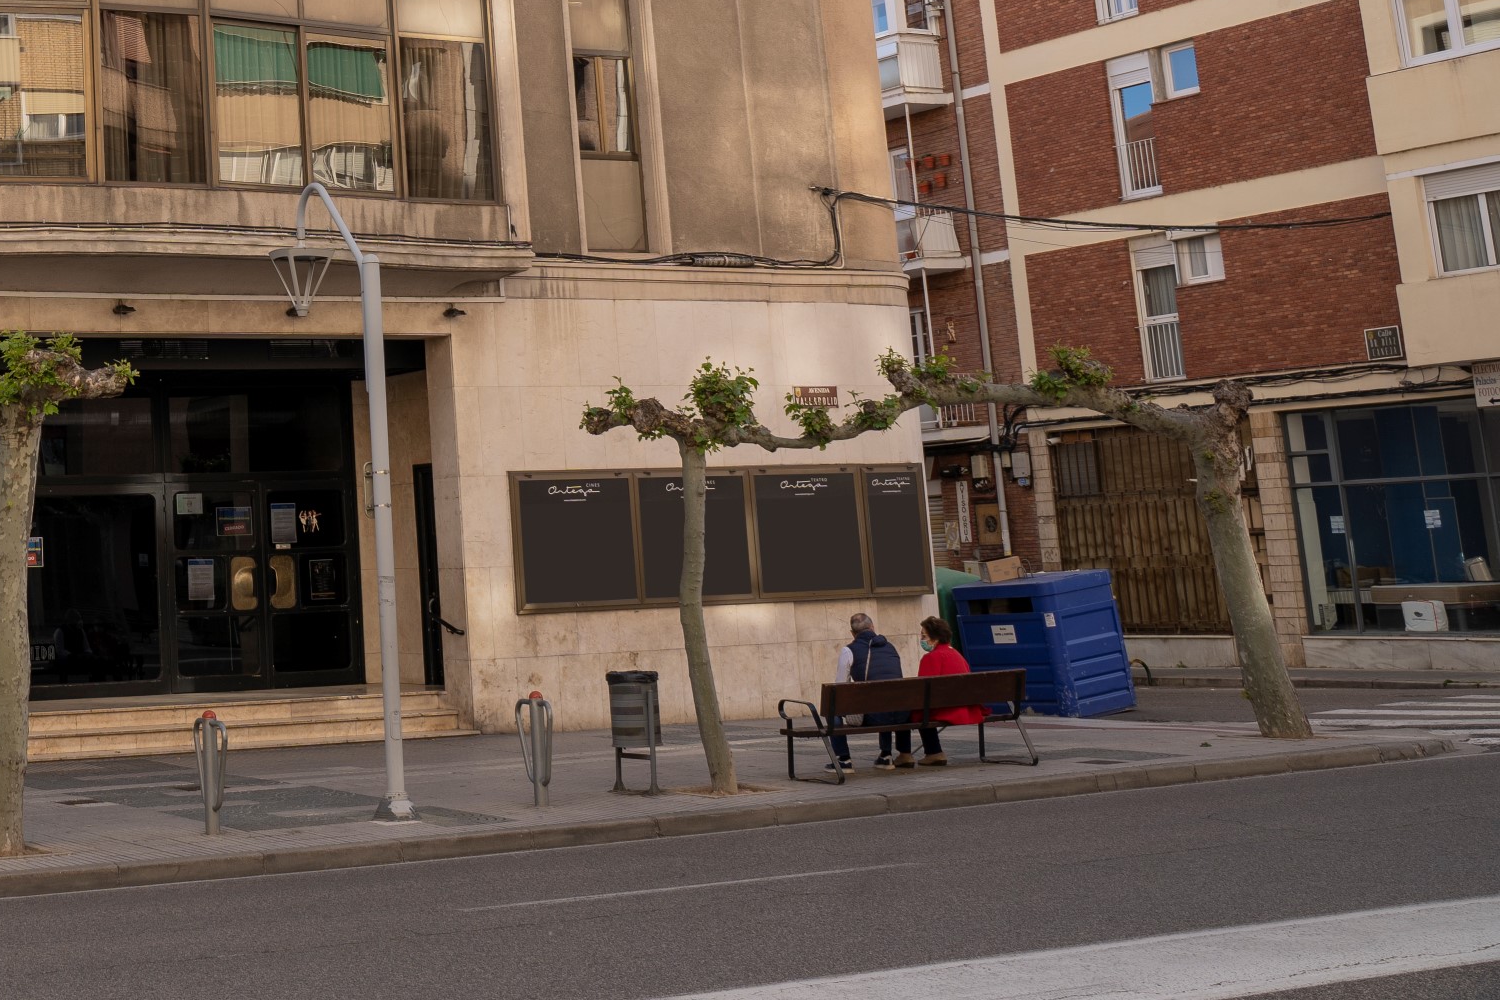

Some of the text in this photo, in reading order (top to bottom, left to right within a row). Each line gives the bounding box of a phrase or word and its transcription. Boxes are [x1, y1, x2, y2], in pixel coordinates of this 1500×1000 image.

[1477, 386, 1500, 397] FOTOC
[795, 396, 838, 406] VALLADOLID
[779, 480, 828, 491] Ortega
[871, 478, 911, 488] Ortega
[547, 485, 601, 497] Ortega
